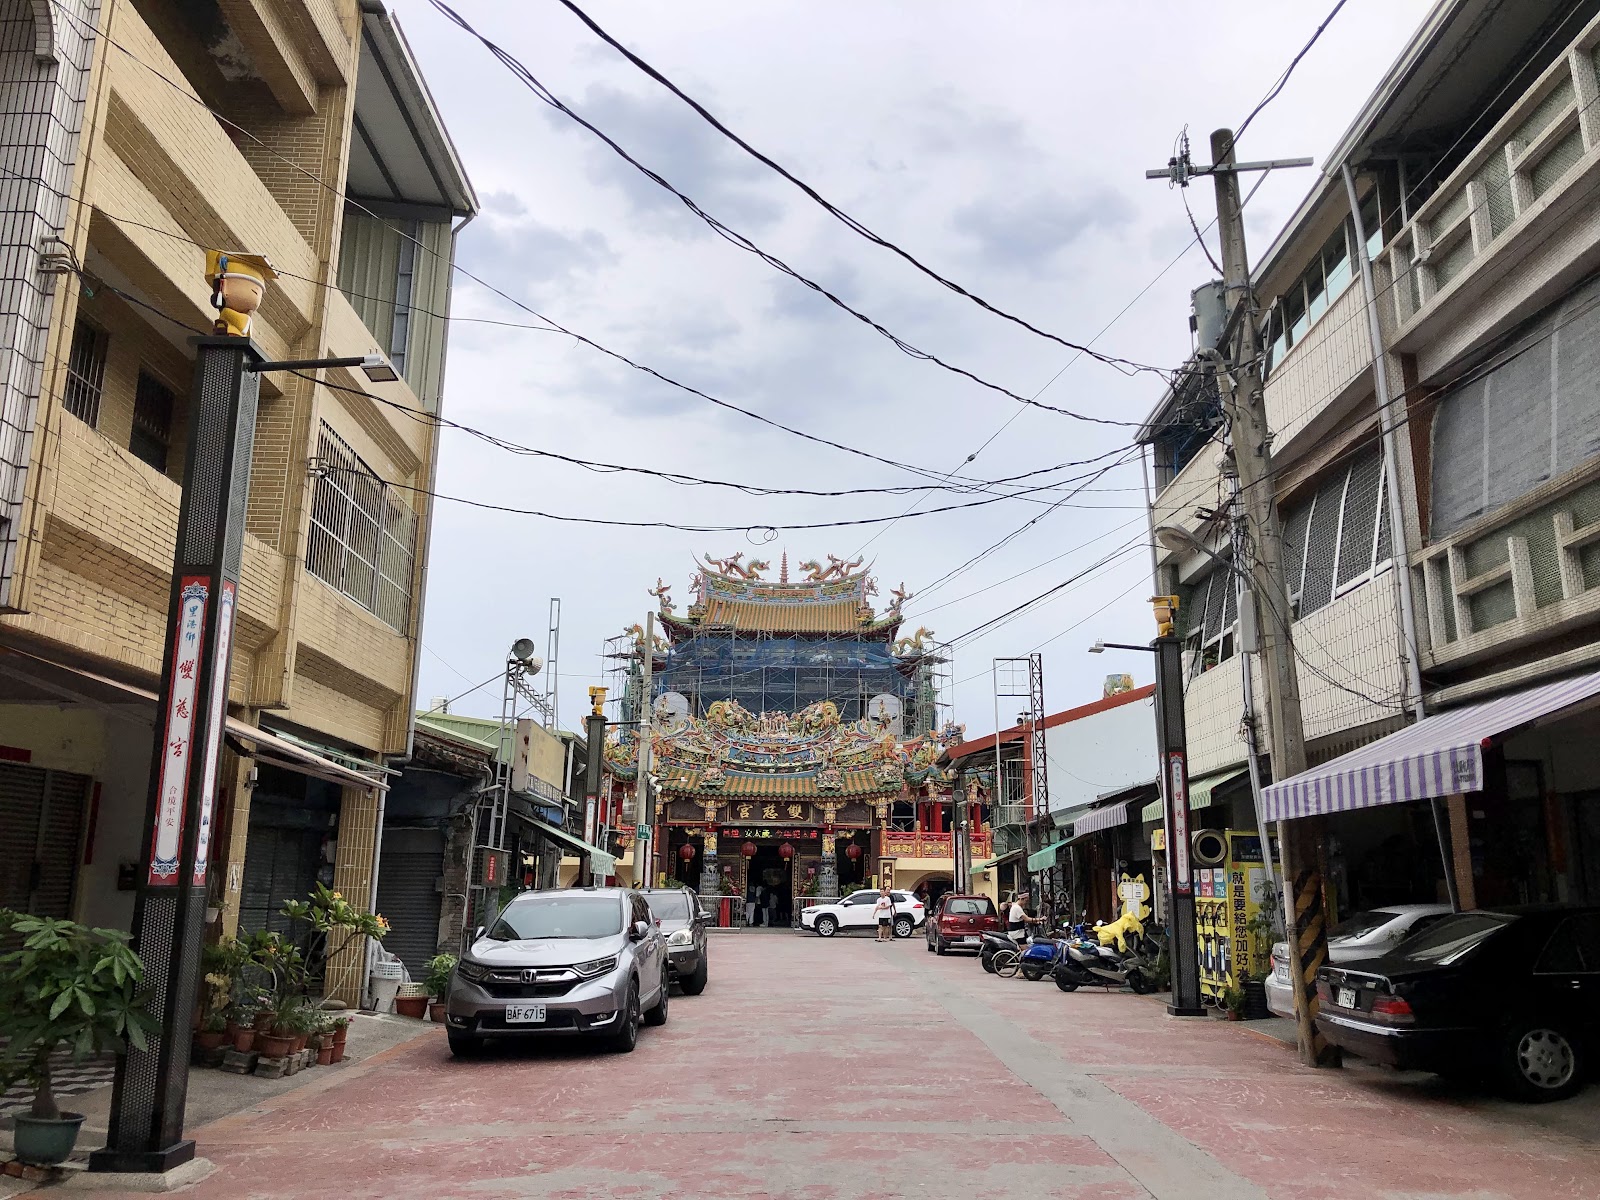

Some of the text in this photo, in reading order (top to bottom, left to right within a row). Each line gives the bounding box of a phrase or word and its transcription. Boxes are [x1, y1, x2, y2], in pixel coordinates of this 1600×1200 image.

[185, 604, 199, 648] 里港鄉
[169, 658, 195, 758] 雙慈宮
[165, 785, 178, 828] 合境平安
[736, 803, 804, 819] 雙慈宮
